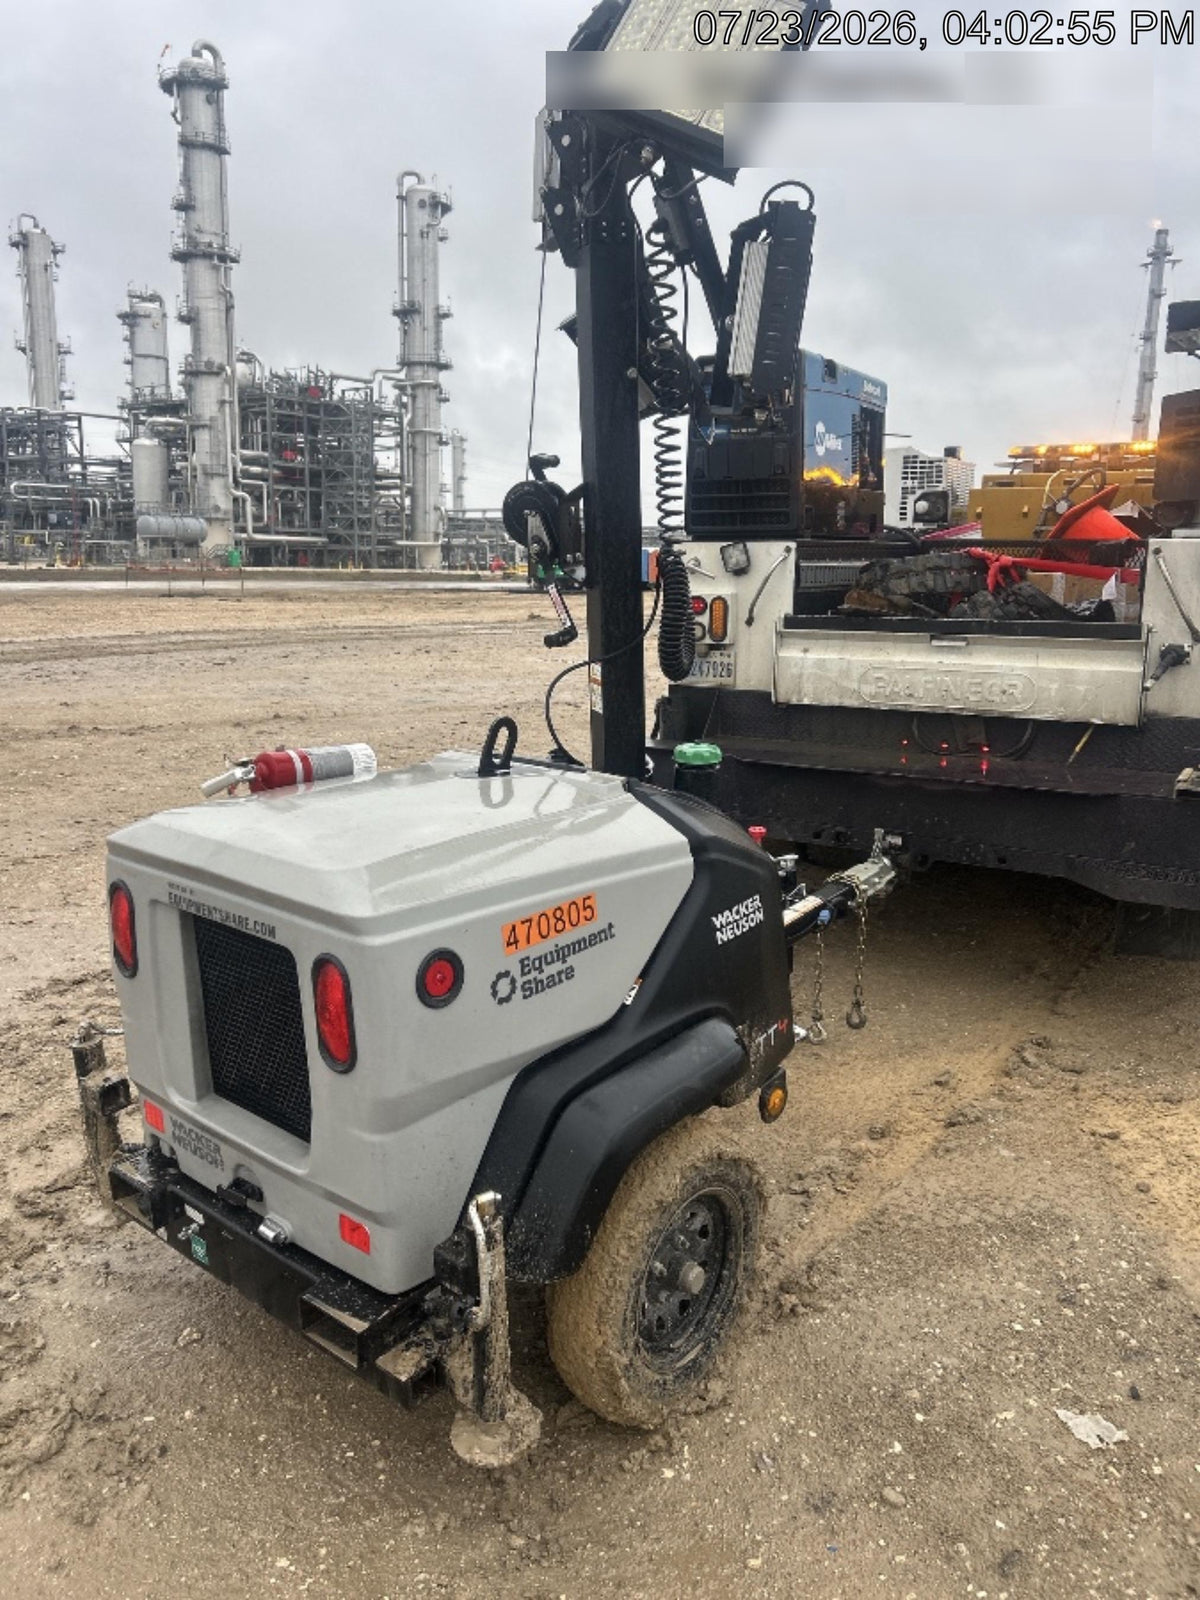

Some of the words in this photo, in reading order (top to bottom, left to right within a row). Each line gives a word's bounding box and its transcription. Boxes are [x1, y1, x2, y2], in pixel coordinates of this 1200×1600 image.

[506, 895, 595, 950] 470805
[711, 894, 762, 929] WACKER
[716, 908, 764, 945] NEUSON
[519, 922, 616, 977] Equipment
[520, 964, 576, 1000] Share
[169, 1115, 220, 1153] WACKER
[171, 1130, 225, 1171] NEUSON
